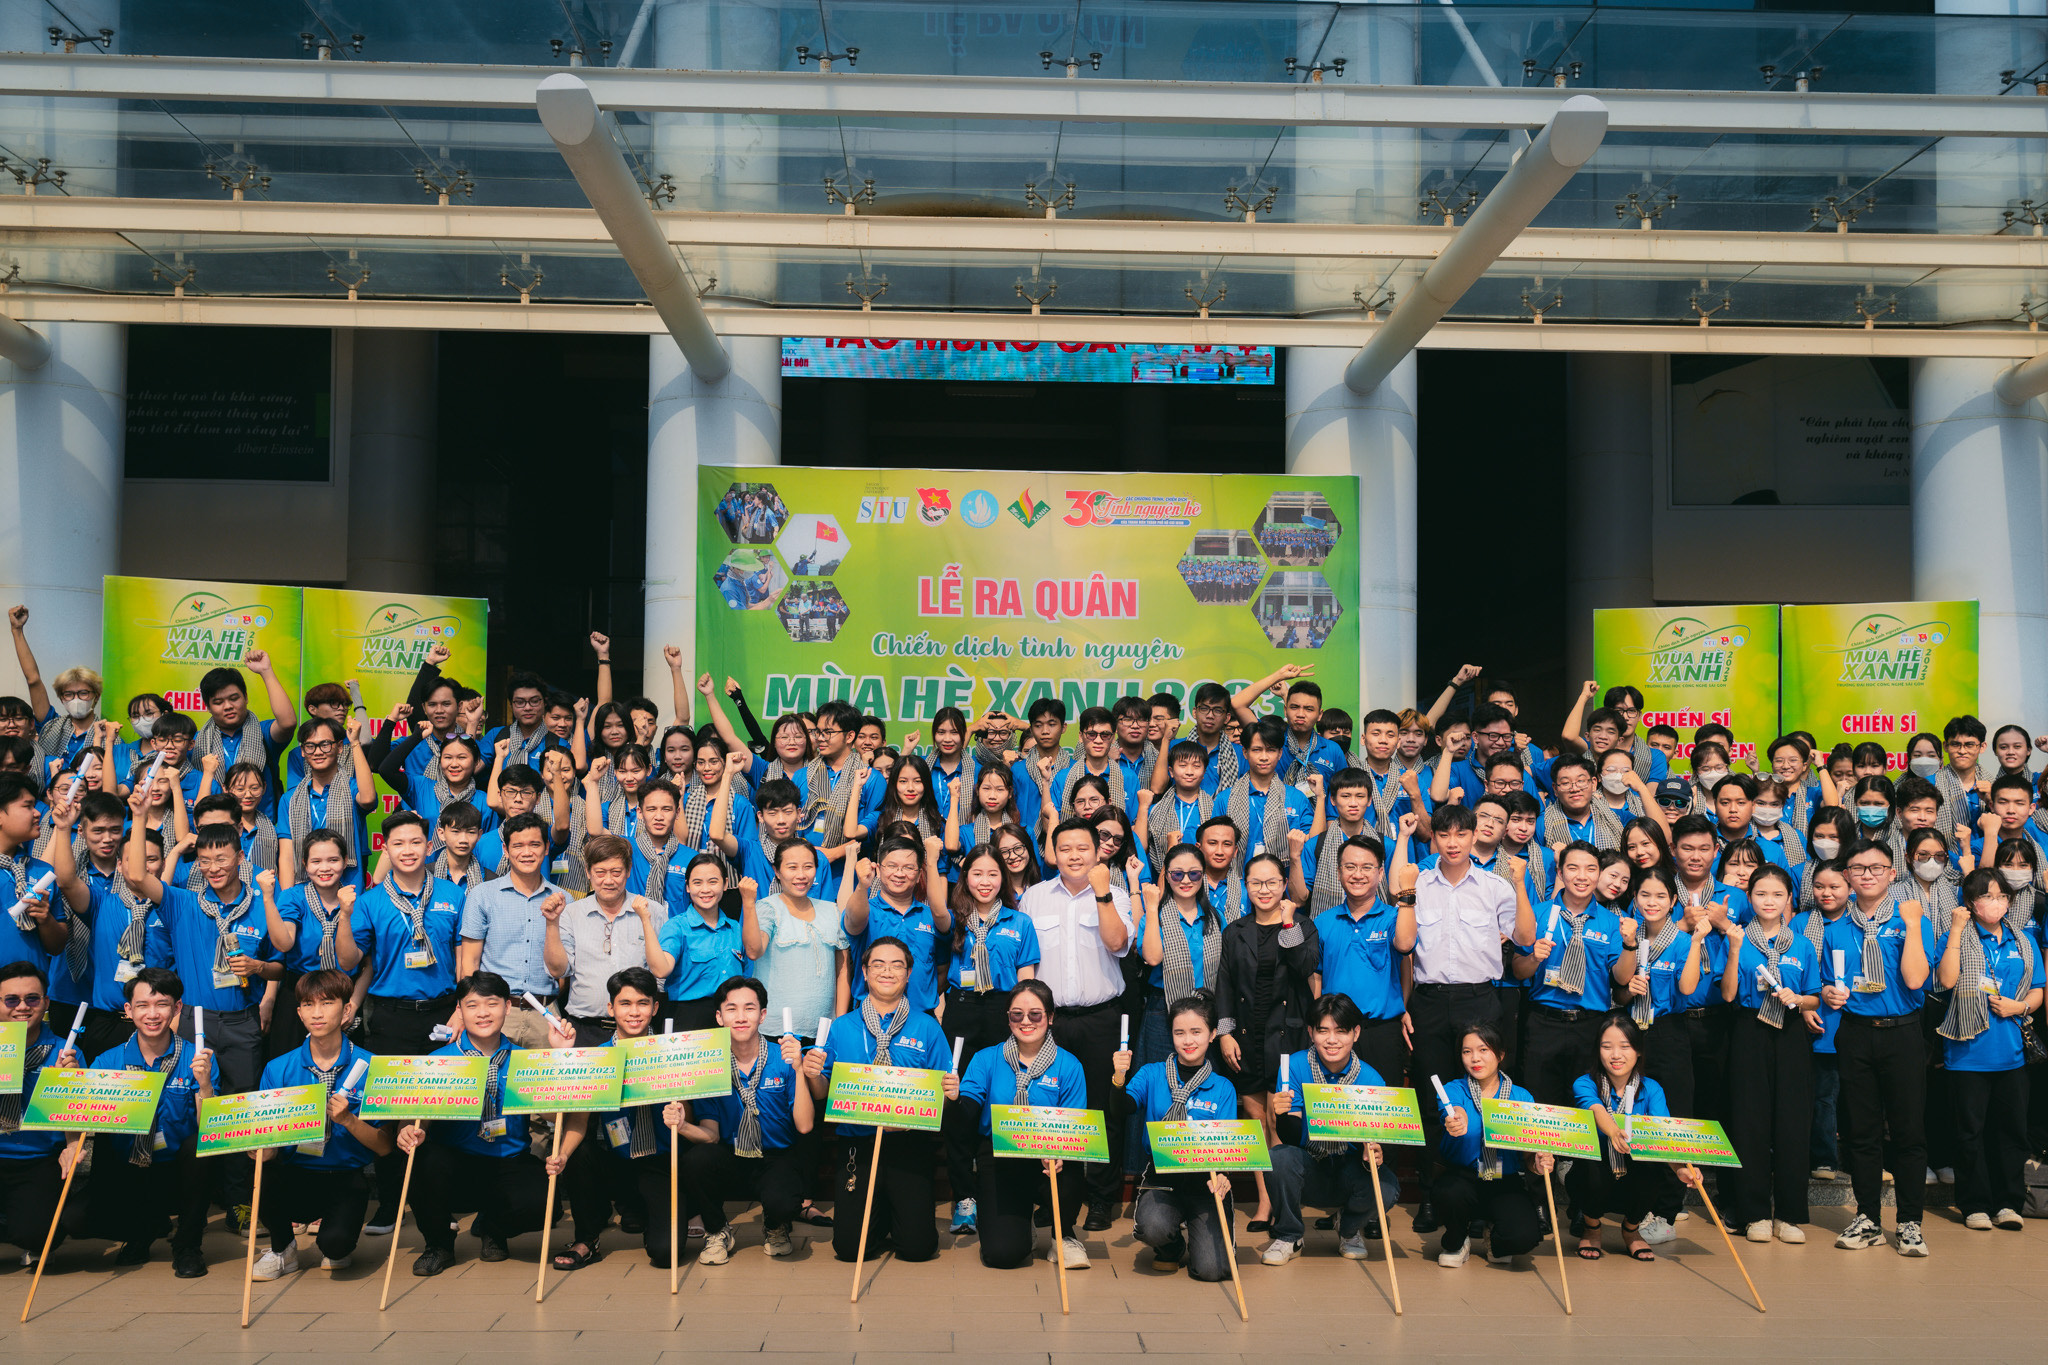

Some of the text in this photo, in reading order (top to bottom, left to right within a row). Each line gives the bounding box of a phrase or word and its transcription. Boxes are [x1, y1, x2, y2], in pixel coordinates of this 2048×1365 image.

[859, 499, 908, 520] STU
[1097, 496, 1201, 520] Tình nguyện hè
[919, 563, 1139, 621] LỄ RA QUÂN
[169, 625, 247, 643] MÙA HÈ
[161, 640, 245, 661] XANH
[363, 636, 406, 652] MÙA
[872, 631, 1185, 670] Chiến dịch tình nguyện
[1653, 648, 1725, 665] MÙA HÈ
[1845, 646, 1923, 663] MÙA HÈ
[1646, 664, 1724, 682] XANH
[1722, 651, 1733, 682] 2023
[1839, 662, 1921, 681] XANH
[1920, 649, 1931, 680] 2023
[762, 662, 892, 721] MÙA
[898, 664, 976, 722] HÈ
[1642, 707, 1731, 728] CHIẾN SĨ
[1841, 709, 1918, 734] CHIẾN SĨ
[666, 1053, 694, 1062] XANH
[697, 1049, 722, 1059] 2023
[374, 1076, 398, 1084] MÙA
[400, 1076, 415, 1084] HÈ
[449, 1077, 476, 1085] 2023
[516, 1068, 539, 1077] MÙA
[541, 1067, 556, 1076] HÈ
[558, 1067, 587, 1075] XANH
[43, 1085, 151, 1098] MÙA HÈ XANH 2023
[837, 1082, 860, 1091] MÙA
[862, 1083, 876, 1092] HÈ
[878, 1086, 907, 1095] XANH
[909, 1088, 935, 1097] 2023
[208, 1113, 234, 1123] MÙA
[236, 1111, 251, 1119] HÈ
[253, 1107, 285, 1118] XANH
[287, 1104, 316, 1113] 2023
[895, 1105, 915, 1116] GIA
[919, 1108, 938, 1118] LAI
[1313, 1101, 1336, 1109] MÙA
[1338, 1102, 1352, 1110] HÈ
[1385, 1105, 1411, 1113] 2023
[293, 1120, 321, 1131] XANH
[1000, 1119, 1023, 1127] MÙA
[1398, 1122, 1421, 1130] XANH
[1531, 1117, 1560, 1126] XANH
[1562, 1121, 1588, 1130] 2023
